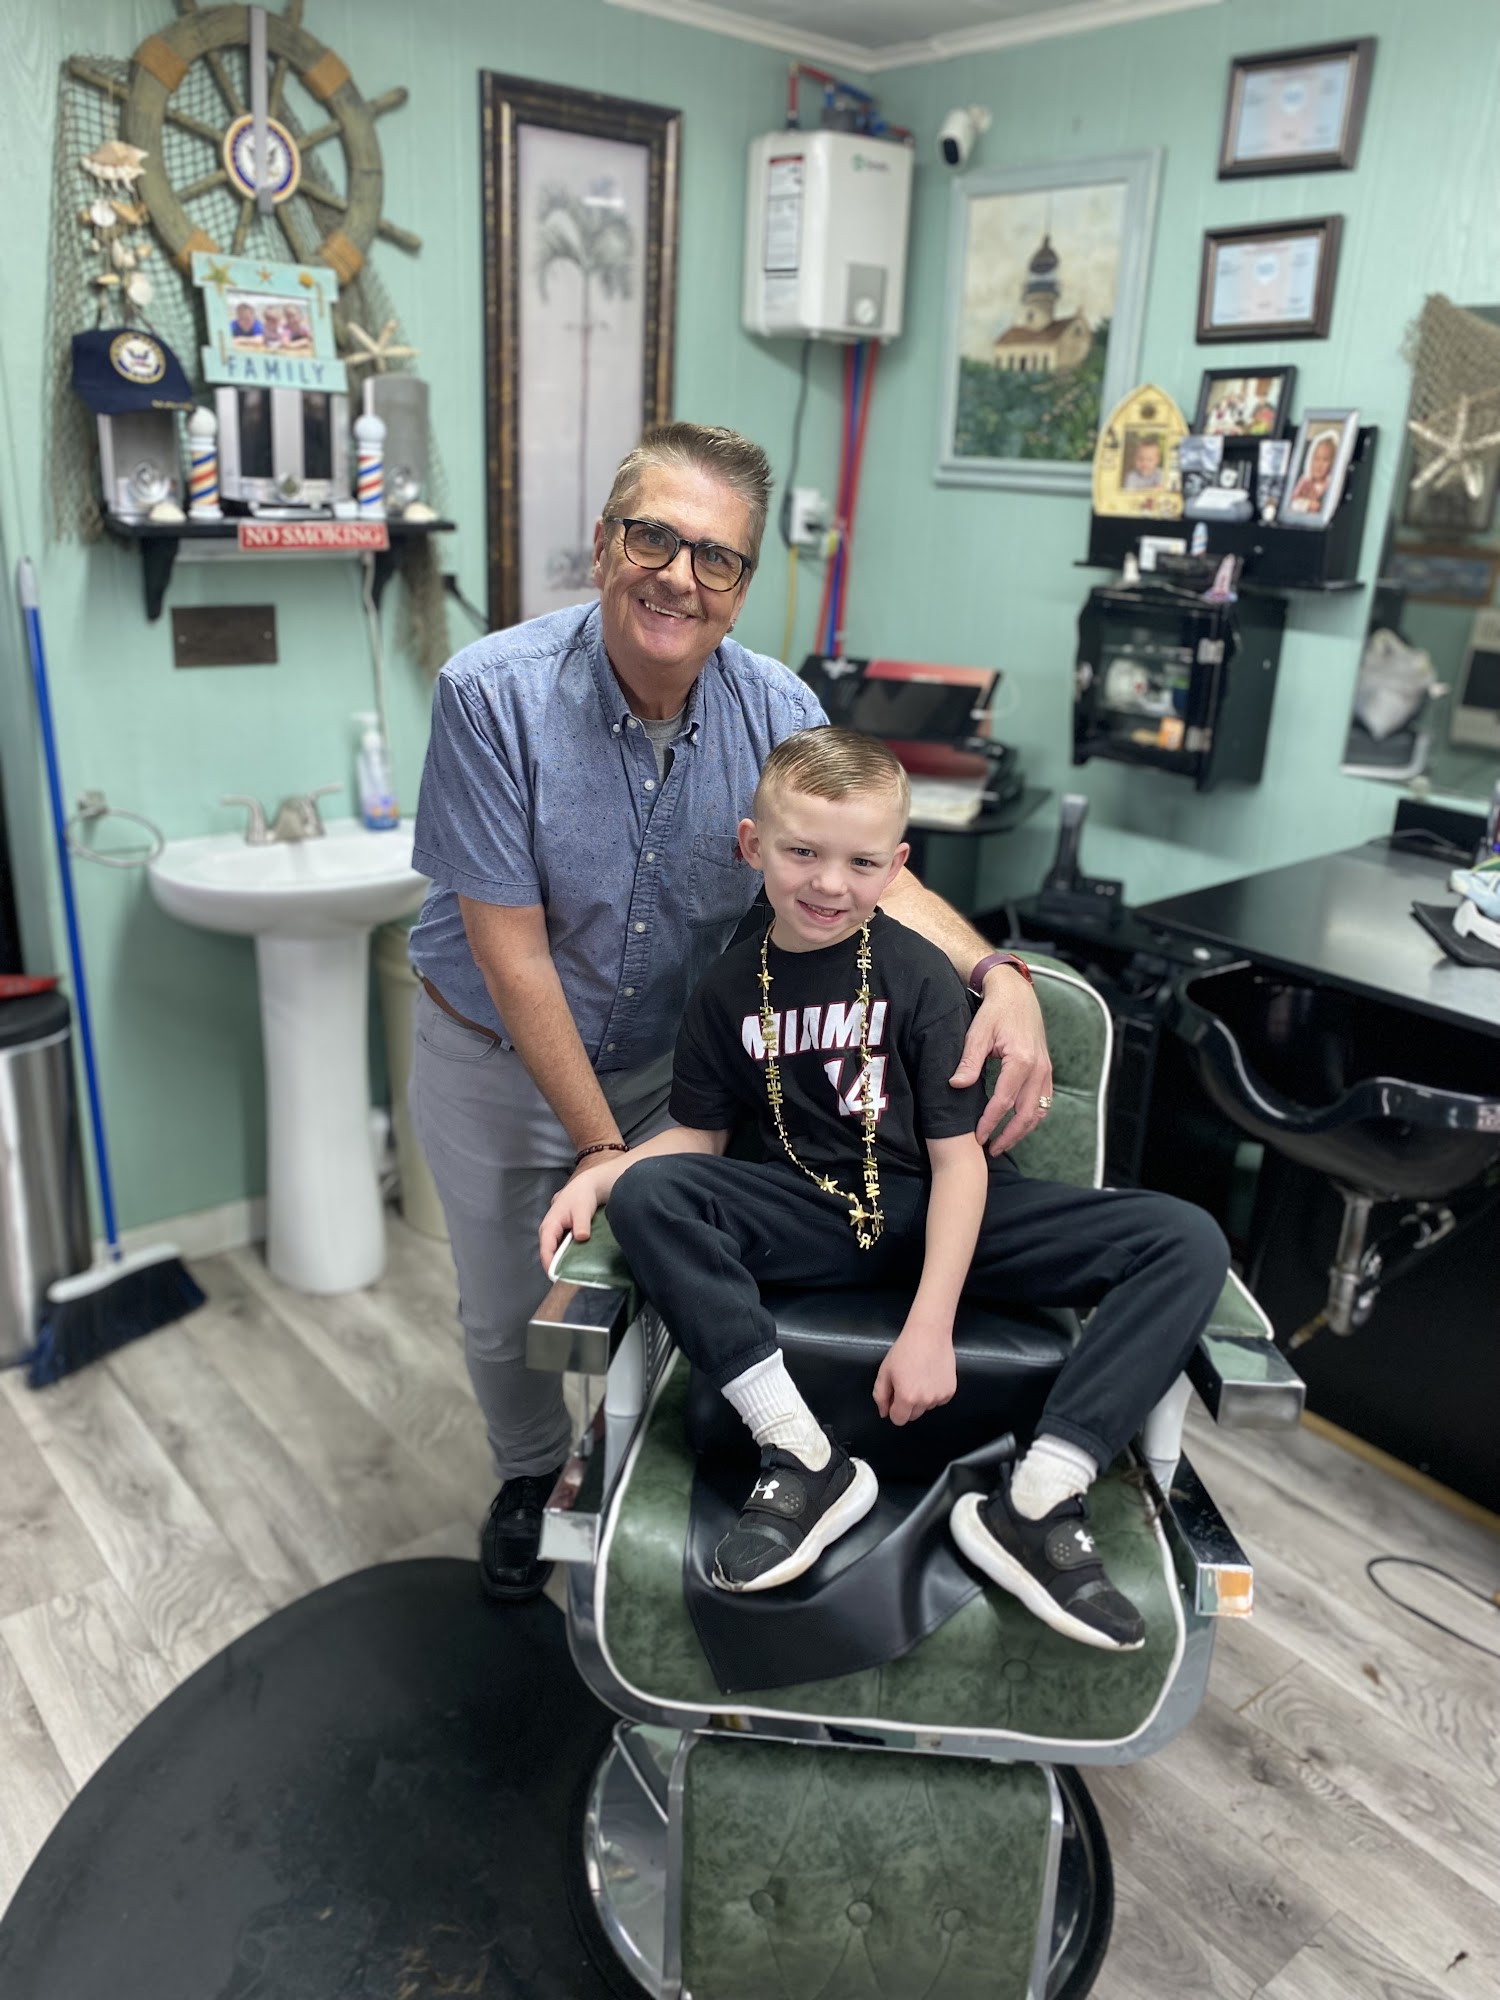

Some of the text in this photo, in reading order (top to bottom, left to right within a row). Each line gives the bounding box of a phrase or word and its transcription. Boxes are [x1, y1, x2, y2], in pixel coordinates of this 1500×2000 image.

[227, 355, 325, 384] FAMILY
[244, 527, 382, 547] NO SMOKING
[741, 1000, 889, 1060] MIAMI
[823, 1055, 889, 1122] 14
